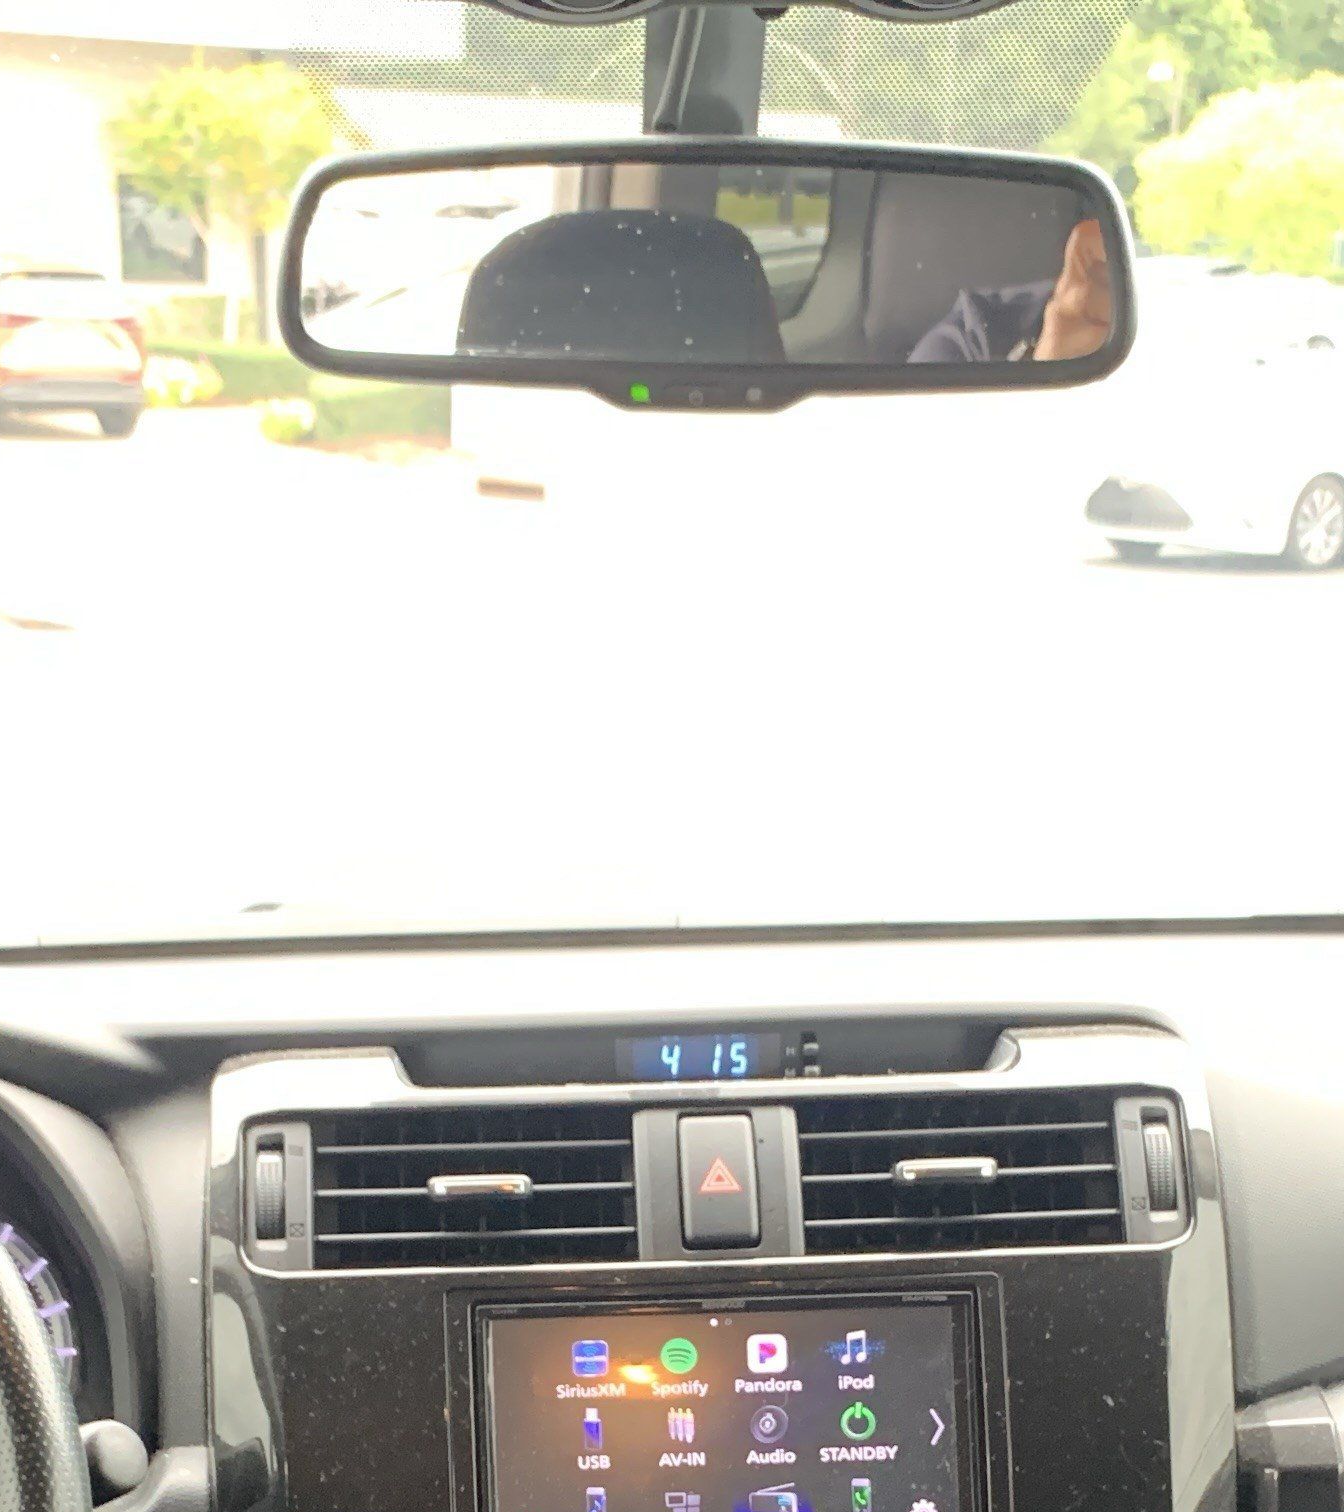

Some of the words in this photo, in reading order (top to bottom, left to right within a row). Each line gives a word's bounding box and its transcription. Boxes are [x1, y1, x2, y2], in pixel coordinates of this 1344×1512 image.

[651, 1379, 709, 1399] Spotify
[734, 1378, 803, 1394] Pandora
[837, 1374, 875, 1390] iPod
[555, 1382, 627, 1400] SiriusXM
[658, 1452, 706, 1467] AV-IN
[746, 1448, 797, 1465] Audio
[819, 1444, 899, 1463] STANDBY
[577, 1455, 611, 1470] USB
